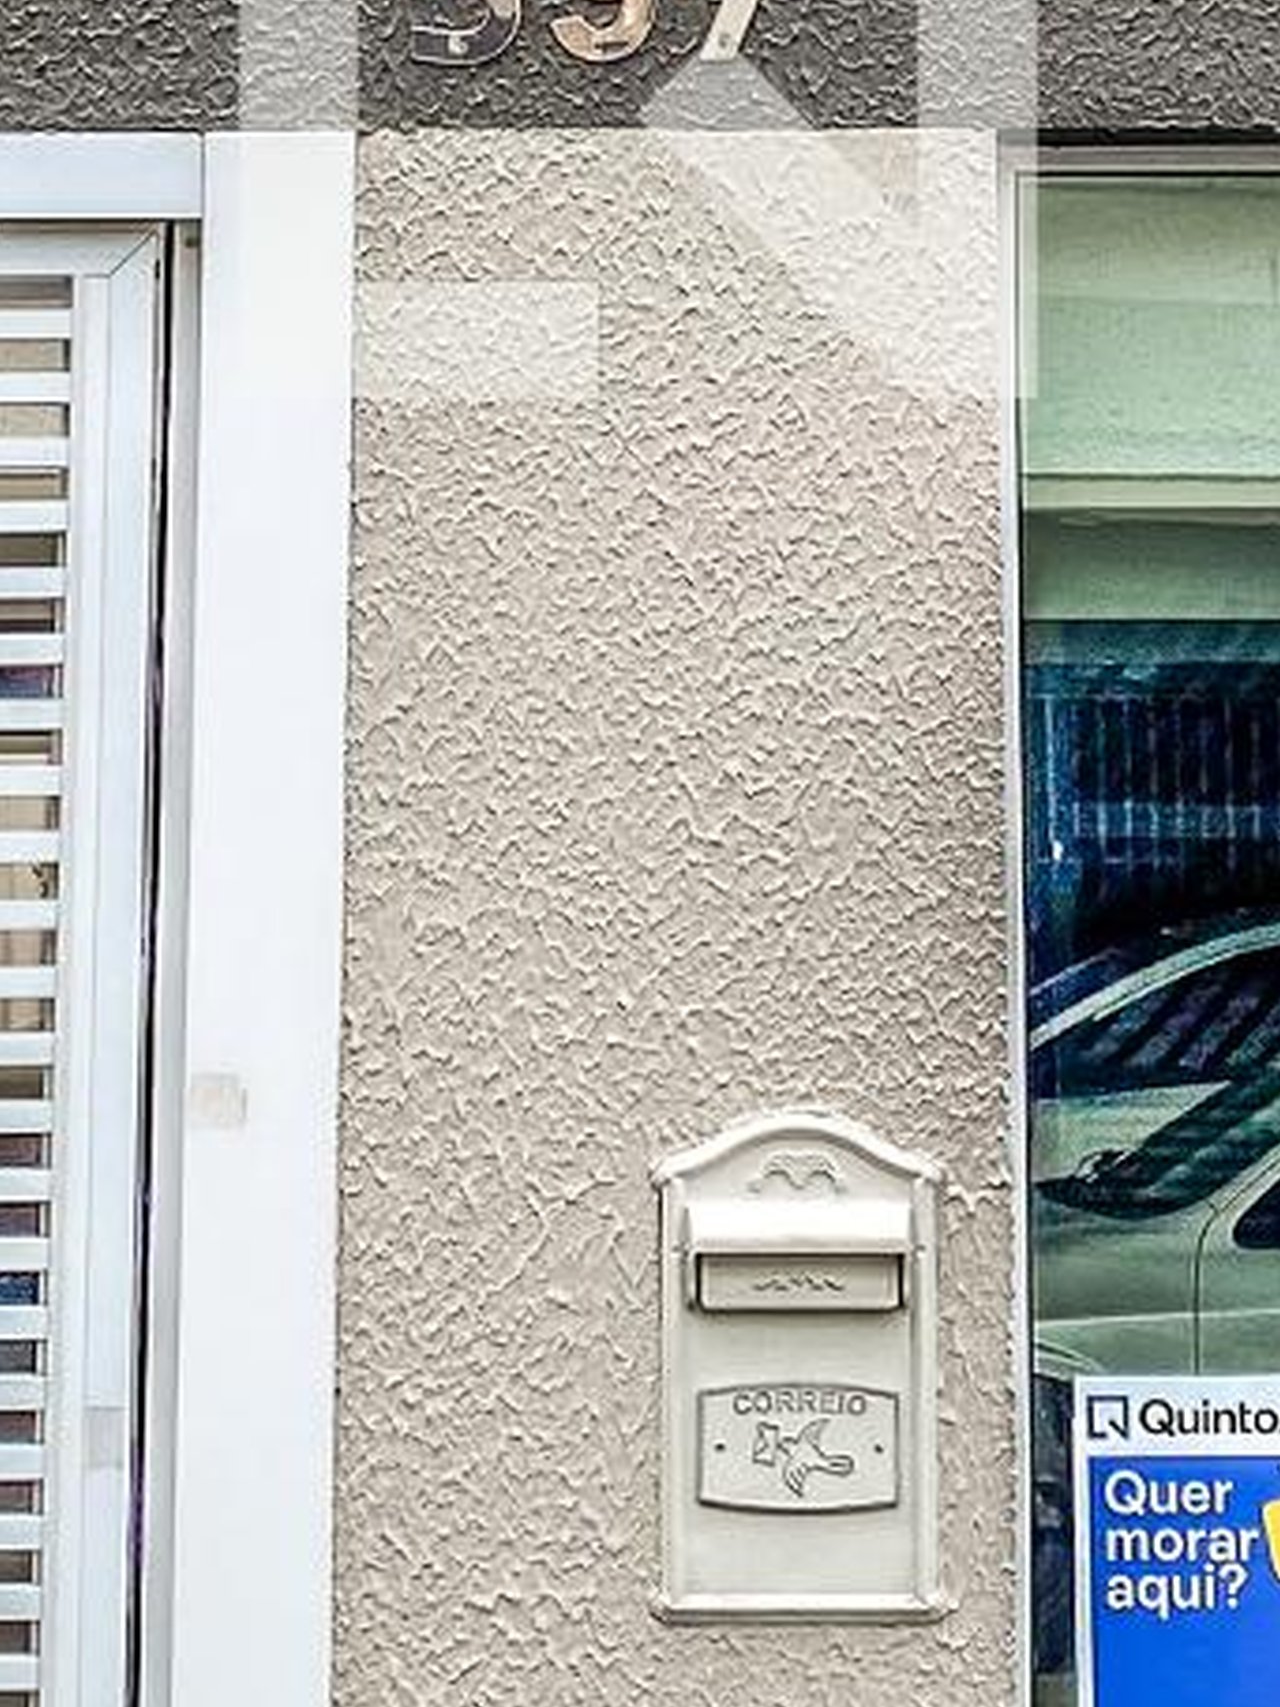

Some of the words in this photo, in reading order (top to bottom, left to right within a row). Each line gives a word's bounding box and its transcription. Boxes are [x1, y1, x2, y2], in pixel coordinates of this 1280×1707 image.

[732, 1390, 870, 1417] CORREIO
[1104, 1470, 1234, 1516] Quer
[1106, 1526, 1259, 1563] morar
[1106, 1563, 1249, 1619] aqui?
